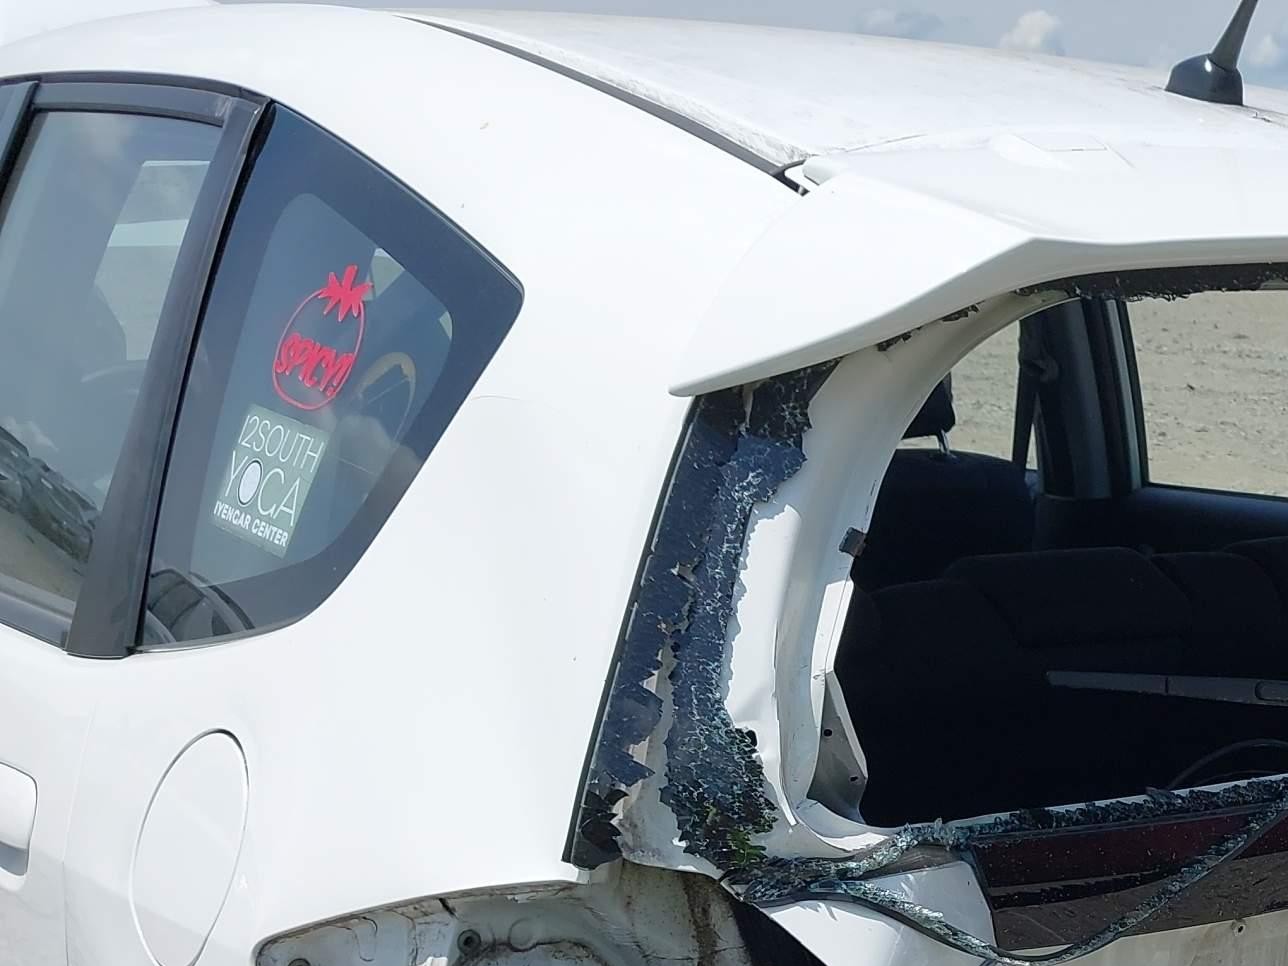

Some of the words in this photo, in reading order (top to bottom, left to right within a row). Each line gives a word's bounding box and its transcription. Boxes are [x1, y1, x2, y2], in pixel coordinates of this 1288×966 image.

[274, 331, 356, 397] SPICY!
[224, 450, 301, 527] YOGA
[213, 500, 252, 531] IYENGAR
[251, 518, 290, 547] CENTER
